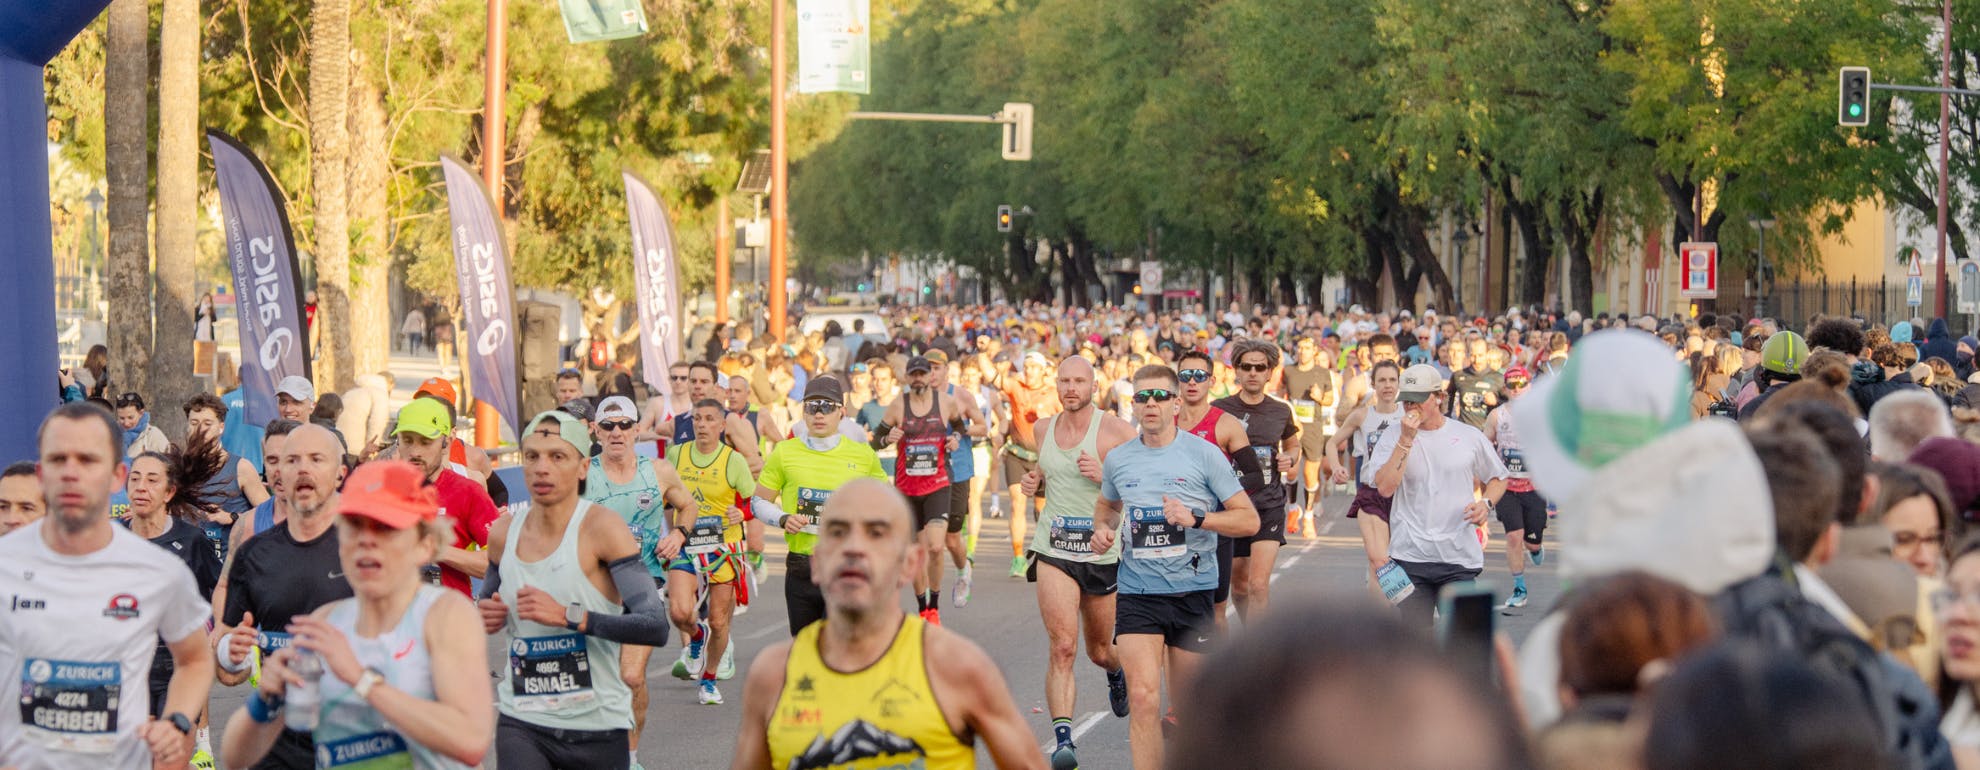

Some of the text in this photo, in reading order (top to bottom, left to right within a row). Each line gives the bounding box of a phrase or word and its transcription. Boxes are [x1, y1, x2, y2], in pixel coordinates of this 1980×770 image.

[689, 535, 719, 545] SIMONE
[1144, 534, 1171, 546] ALEX
[531, 638, 576, 652] ZURICH
[55, 665, 114, 681] ZURICH
[525, 672, 580, 694] ISMAËL
[33, 707, 109, 731] GERBEN
[335, 737, 395, 760] ZURICH
